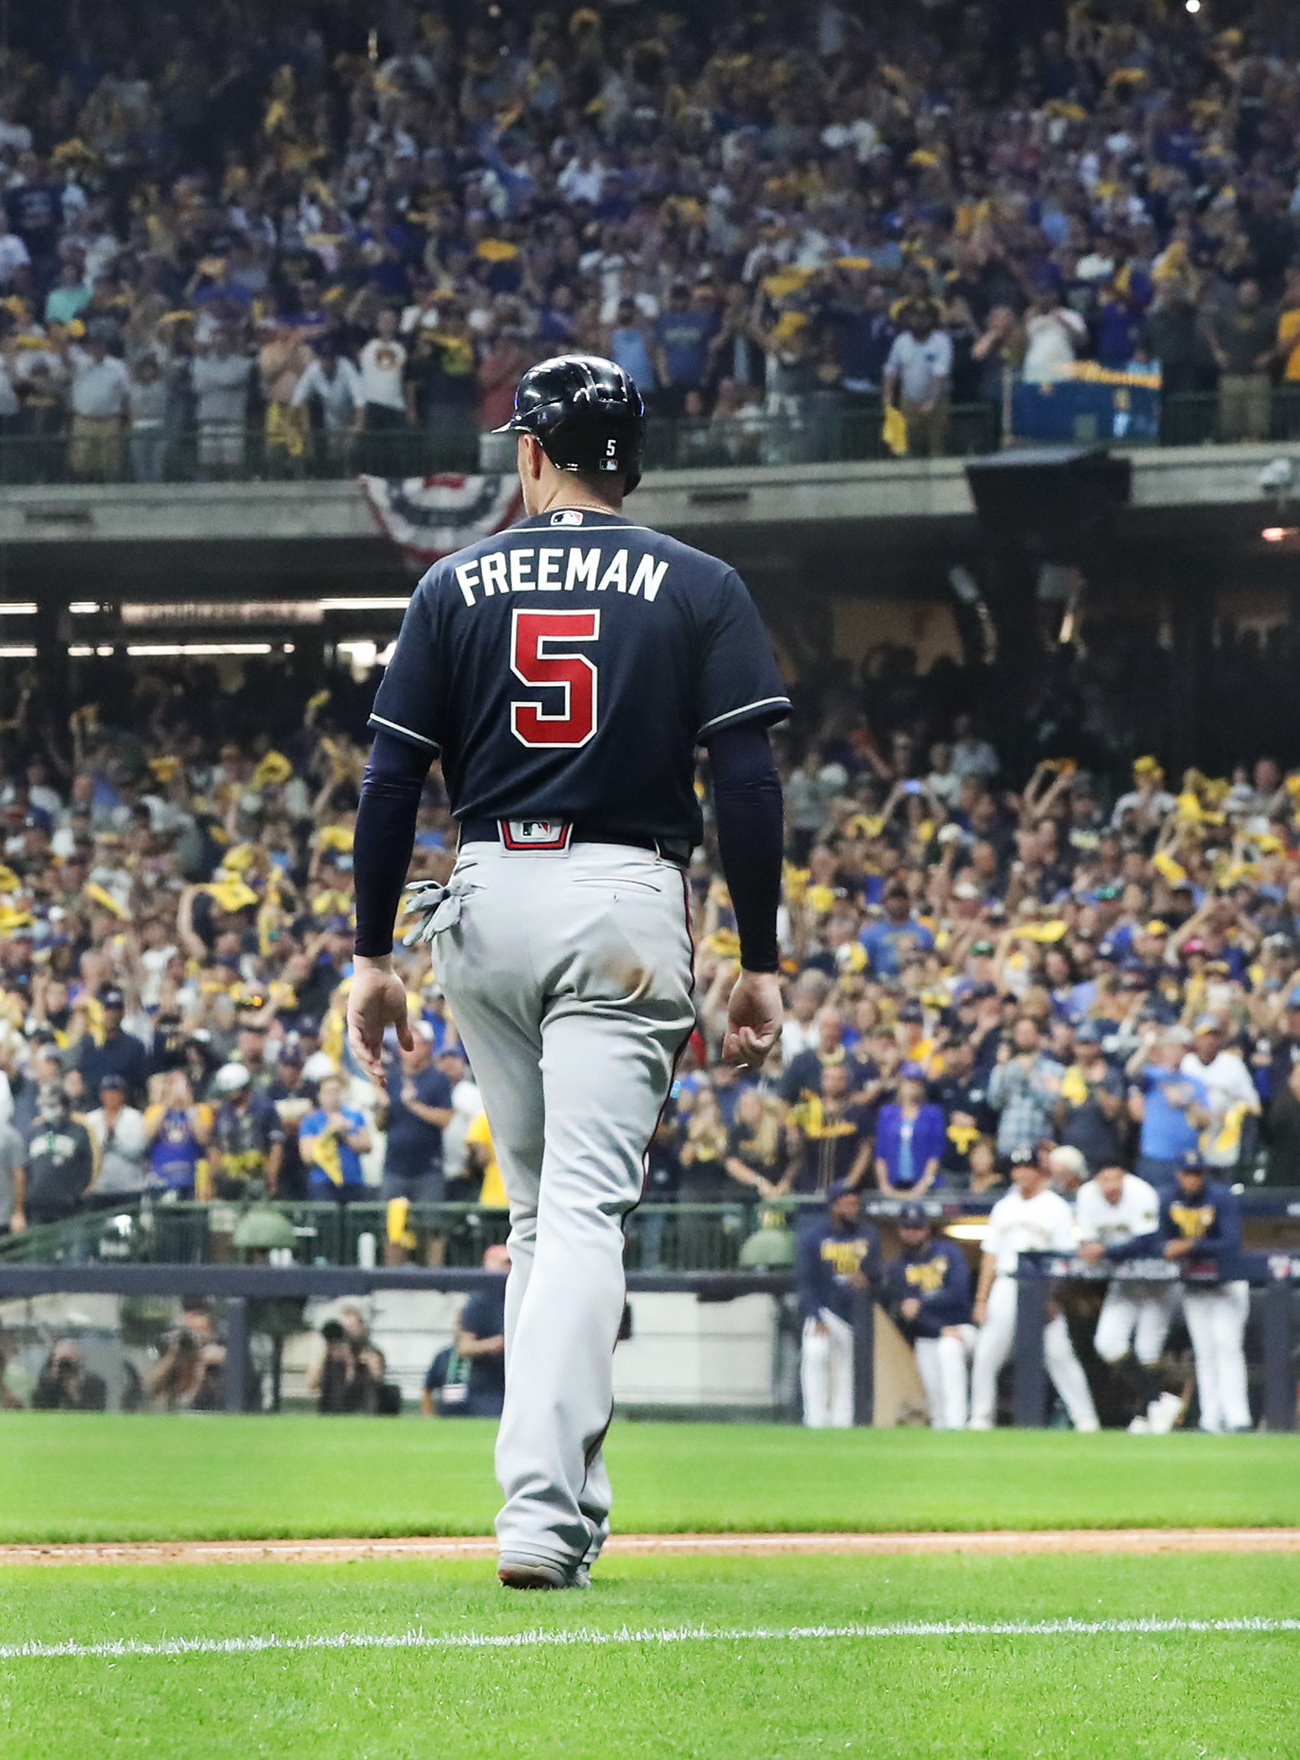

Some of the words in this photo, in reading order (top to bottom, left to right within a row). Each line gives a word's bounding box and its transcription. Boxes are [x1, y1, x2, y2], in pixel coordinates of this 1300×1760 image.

[606, 439, 616, 457] 5
[455, 547, 669, 607] FREEMAN
[510, 608, 600, 748] 5
